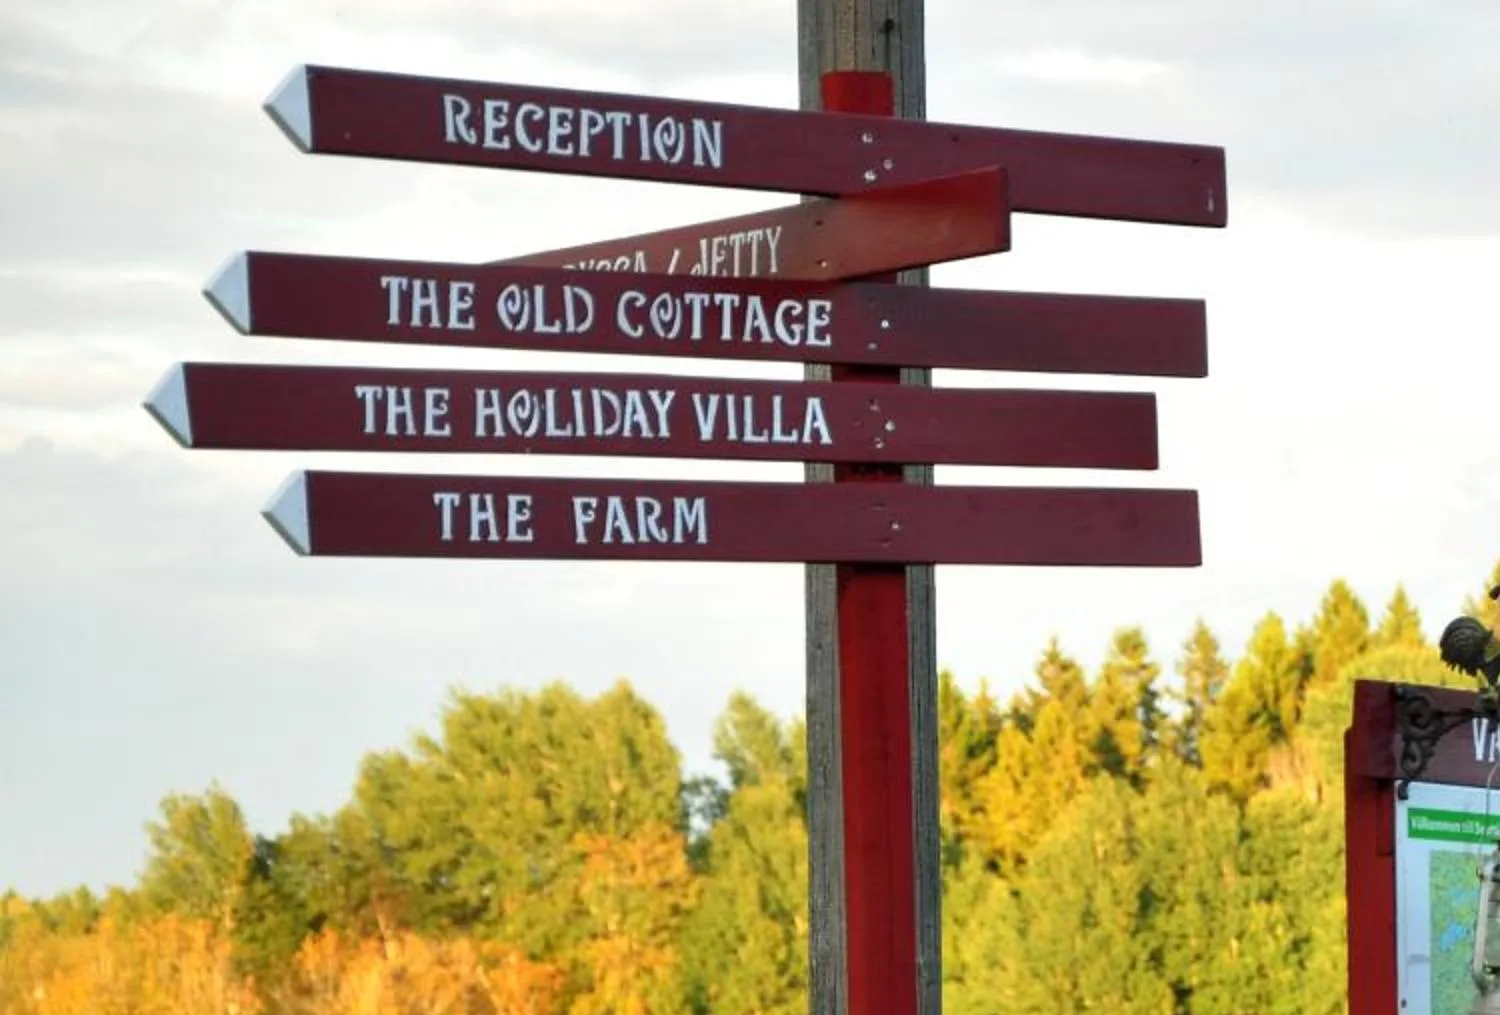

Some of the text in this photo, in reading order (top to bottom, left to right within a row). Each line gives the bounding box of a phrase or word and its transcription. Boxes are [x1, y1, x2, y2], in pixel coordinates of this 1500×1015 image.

[442, 94, 725, 169] RECEPTION
[690, 226, 783, 279] JETTY
[380, 276, 833, 347] THE OLD COTTAGE
[354, 385, 833, 445] THE HOLIDAY VILLA
[433, 492, 709, 545] THE FARM
